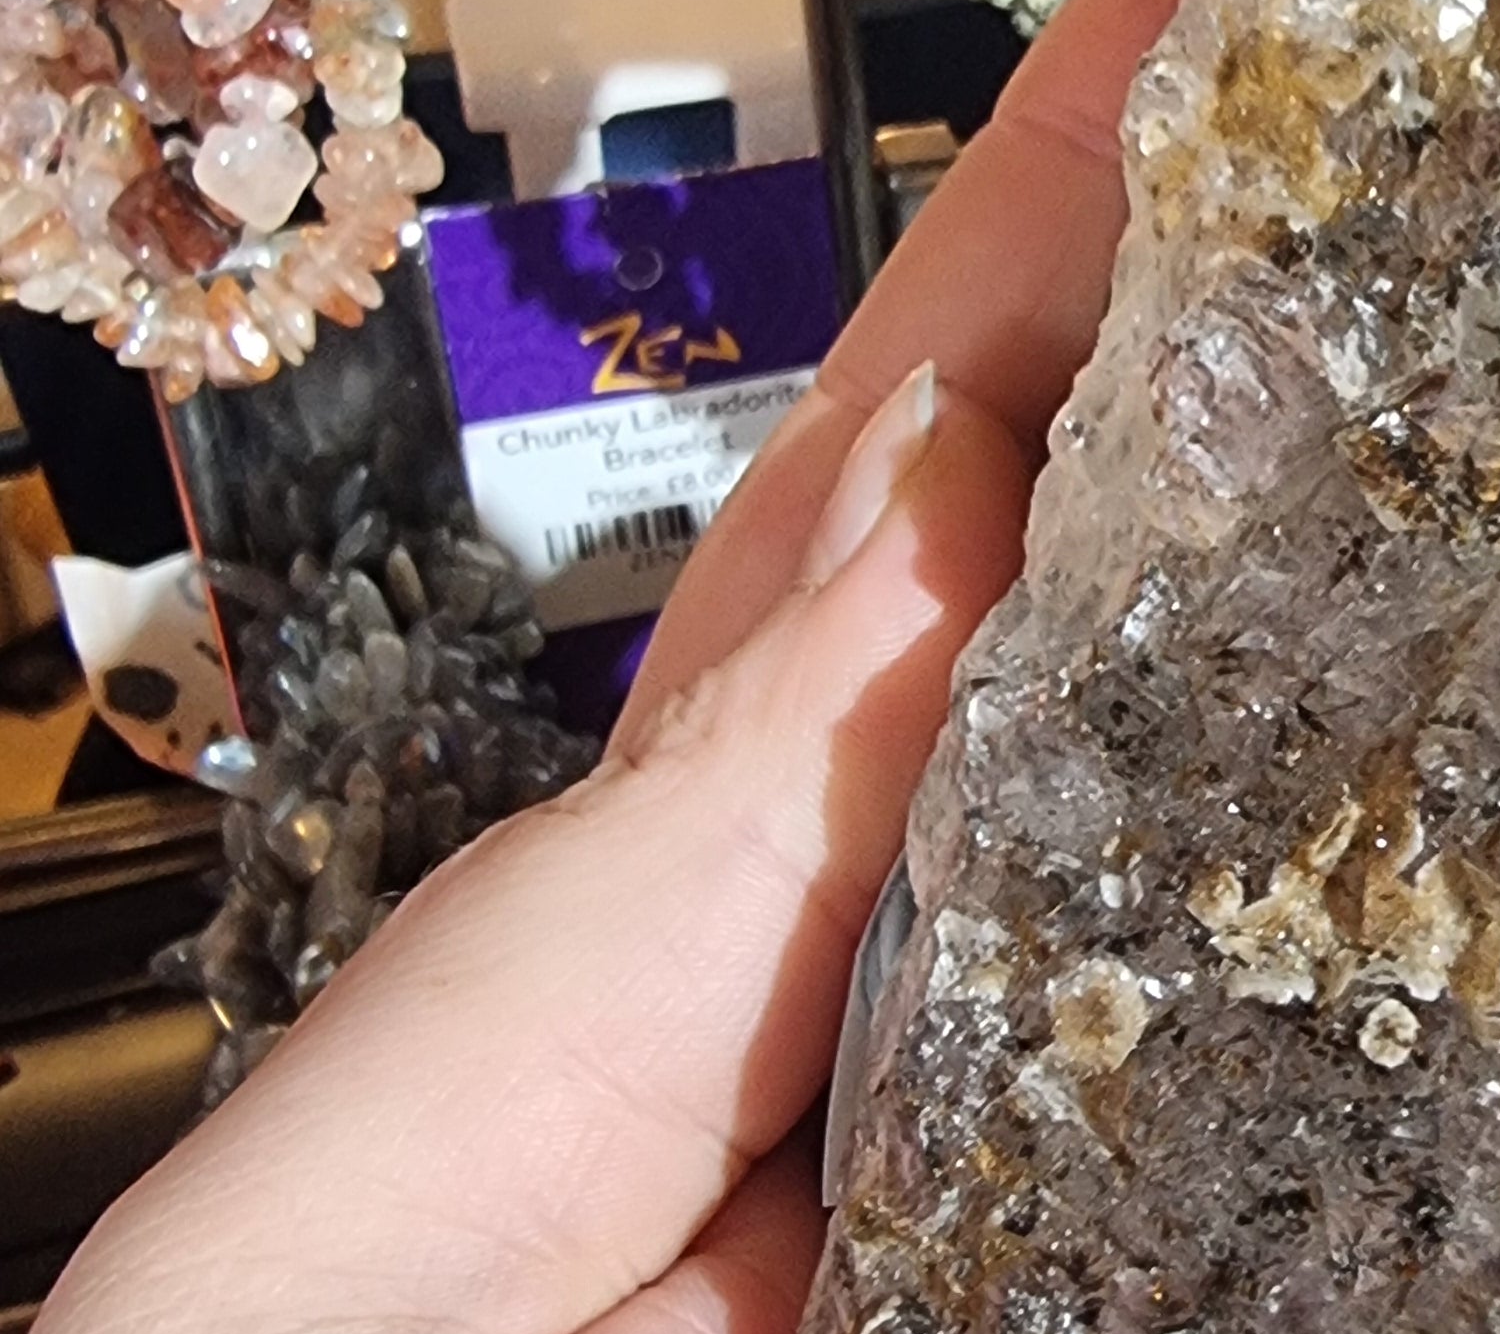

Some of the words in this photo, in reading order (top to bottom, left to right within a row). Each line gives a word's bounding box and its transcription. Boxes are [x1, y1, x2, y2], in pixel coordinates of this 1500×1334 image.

[579, 310, 743, 394] ZEN
[497, 417, 622, 456] Chunky
[603, 431, 736, 473] Bracelet
